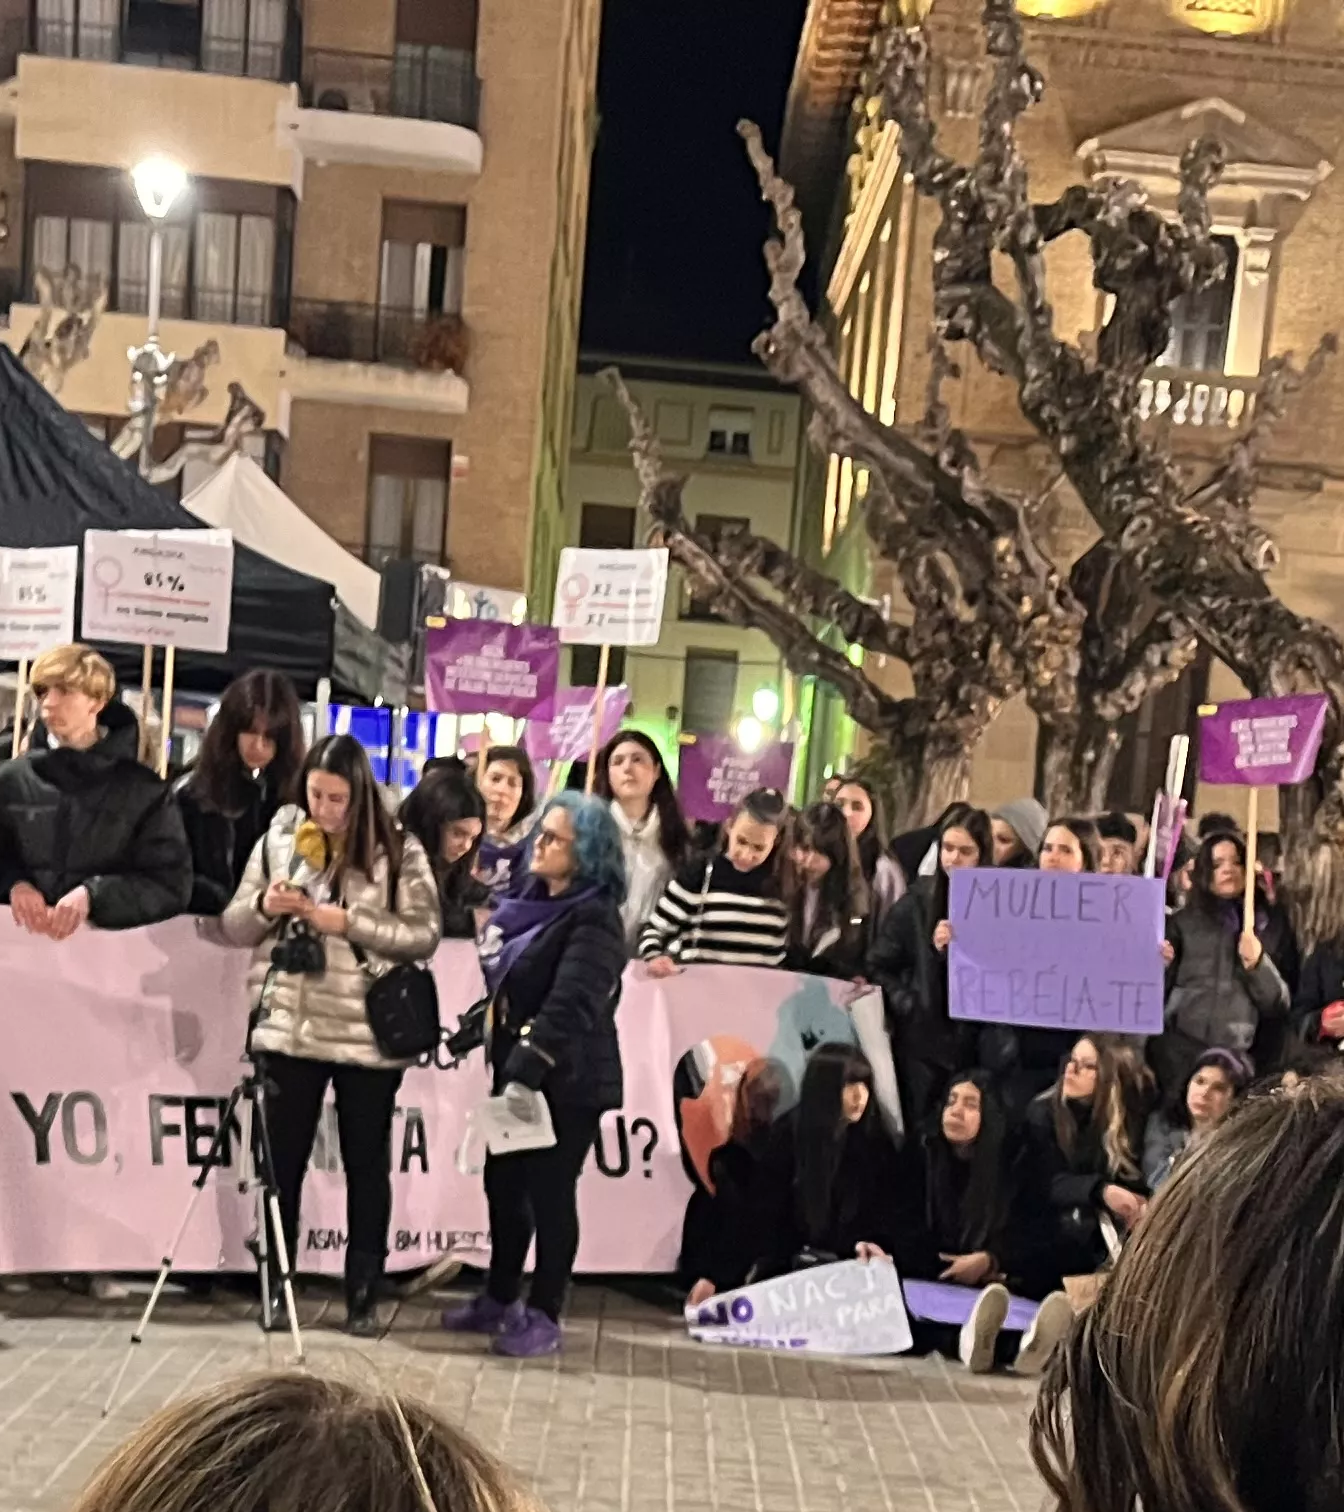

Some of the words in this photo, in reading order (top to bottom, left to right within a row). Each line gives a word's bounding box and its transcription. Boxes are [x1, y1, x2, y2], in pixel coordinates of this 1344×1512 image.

[964, 877, 1133, 923] MULLER
[10, 1089, 124, 1175] YO,
[395, 1229, 421, 1252] 8M
[427, 1231, 492, 1251] HUESC
[697, 1295, 754, 1326] NO
